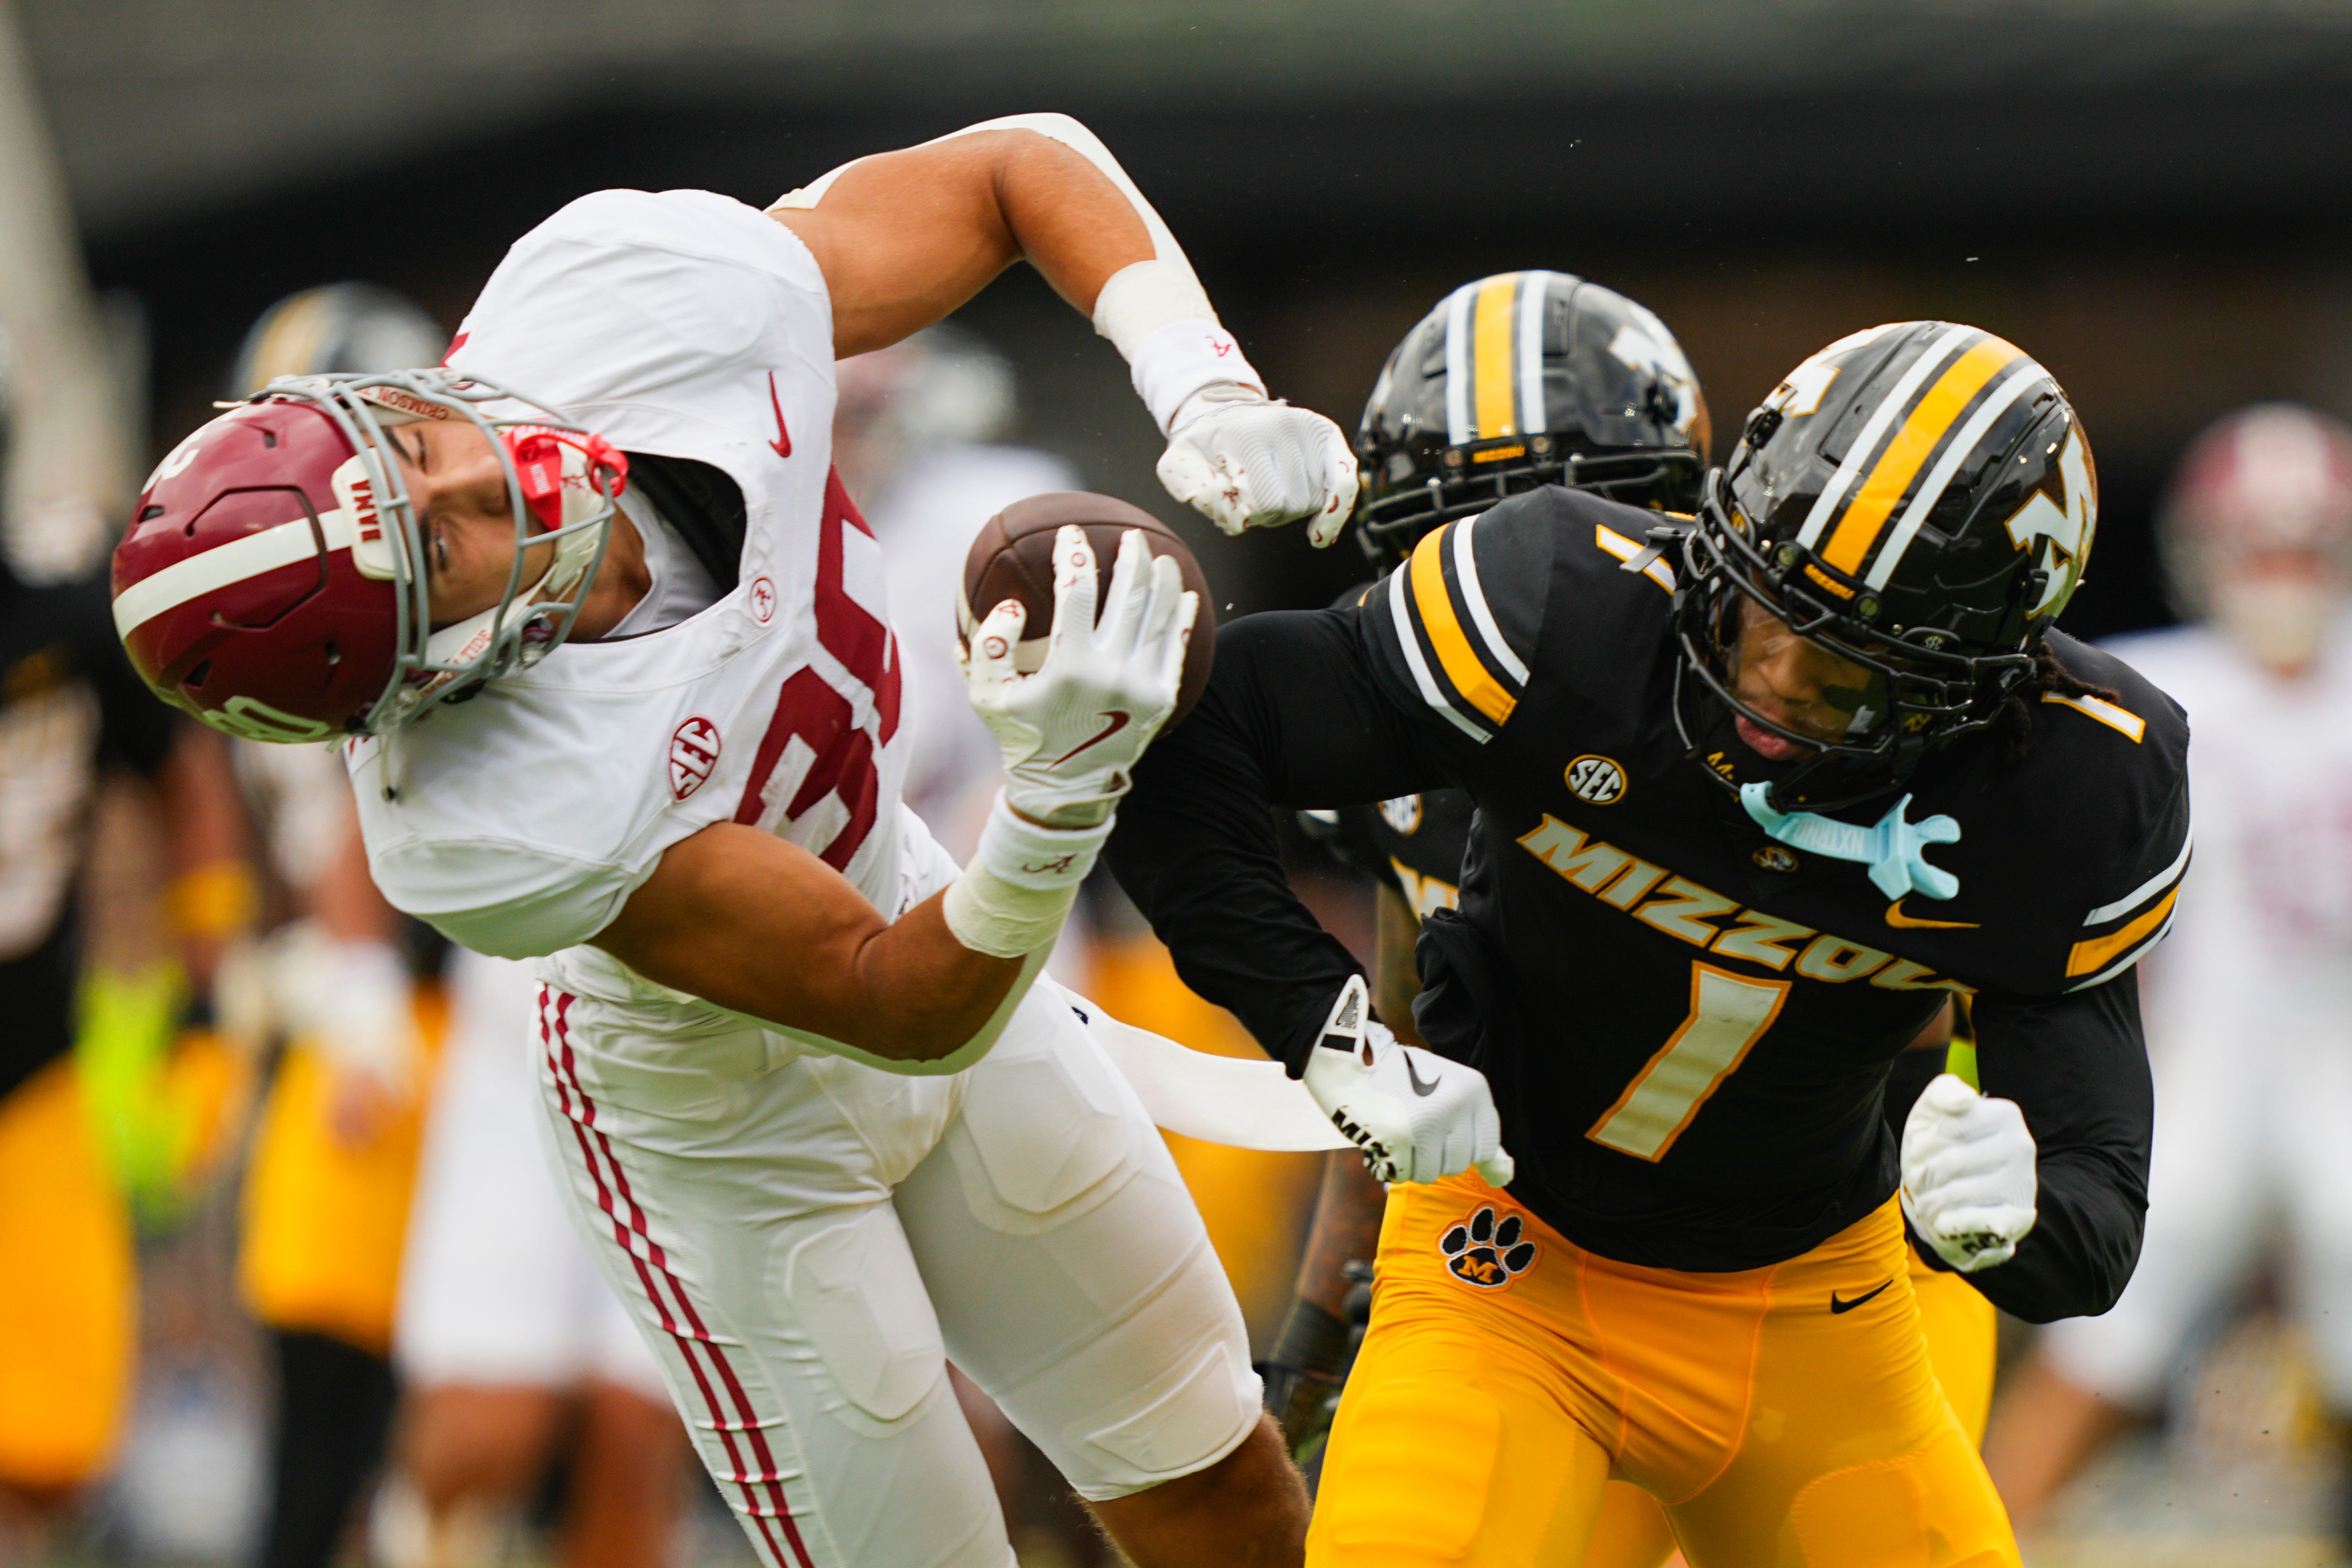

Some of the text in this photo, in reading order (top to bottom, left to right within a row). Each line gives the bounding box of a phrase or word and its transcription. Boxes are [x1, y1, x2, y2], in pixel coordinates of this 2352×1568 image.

[350, 478, 381, 543] BAMA
[671, 721, 719, 797] SEC
[1569, 759, 1621, 801] SEC
[1584, 959, 1793, 1163] 1
[1457, 1255, 1498, 1284] M
